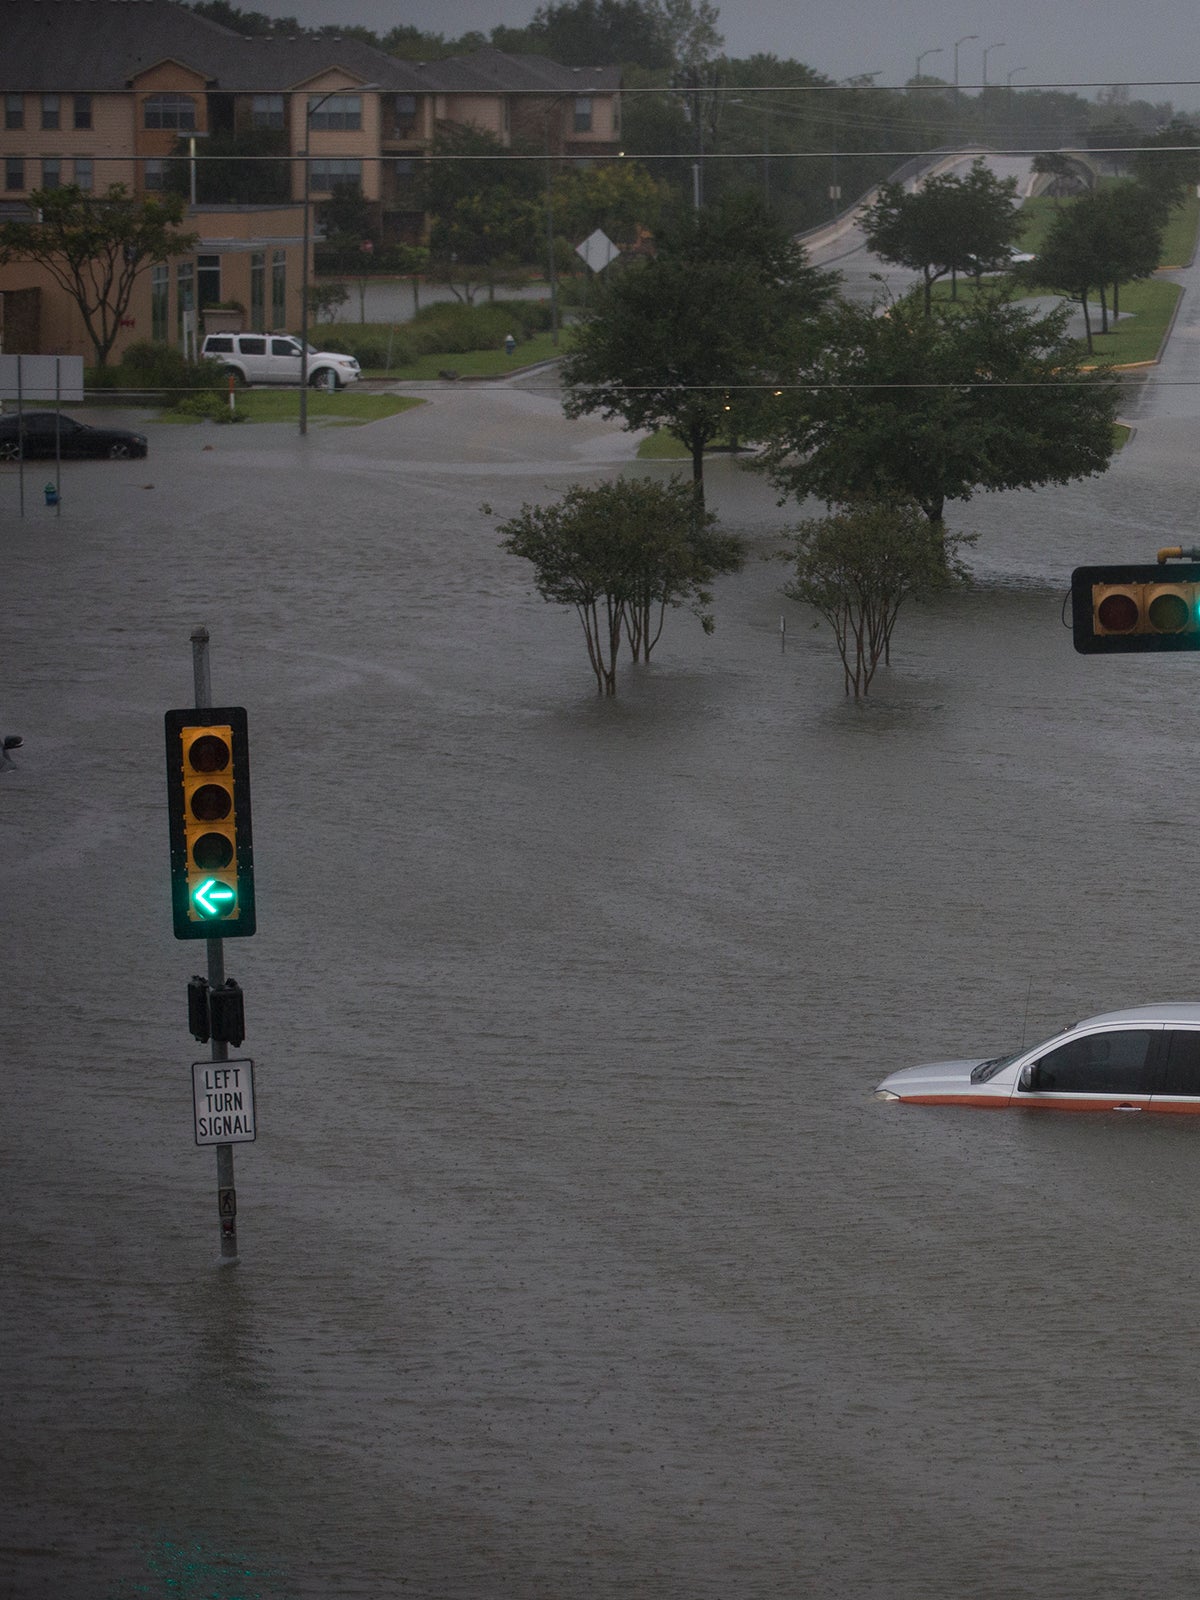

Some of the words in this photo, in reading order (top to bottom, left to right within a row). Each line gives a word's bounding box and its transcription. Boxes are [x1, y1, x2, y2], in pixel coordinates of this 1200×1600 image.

[205, 1068, 241, 1090] LEFT
[206, 1092, 243, 1113] TURN
[199, 1115, 252, 1137] SIGNAL
